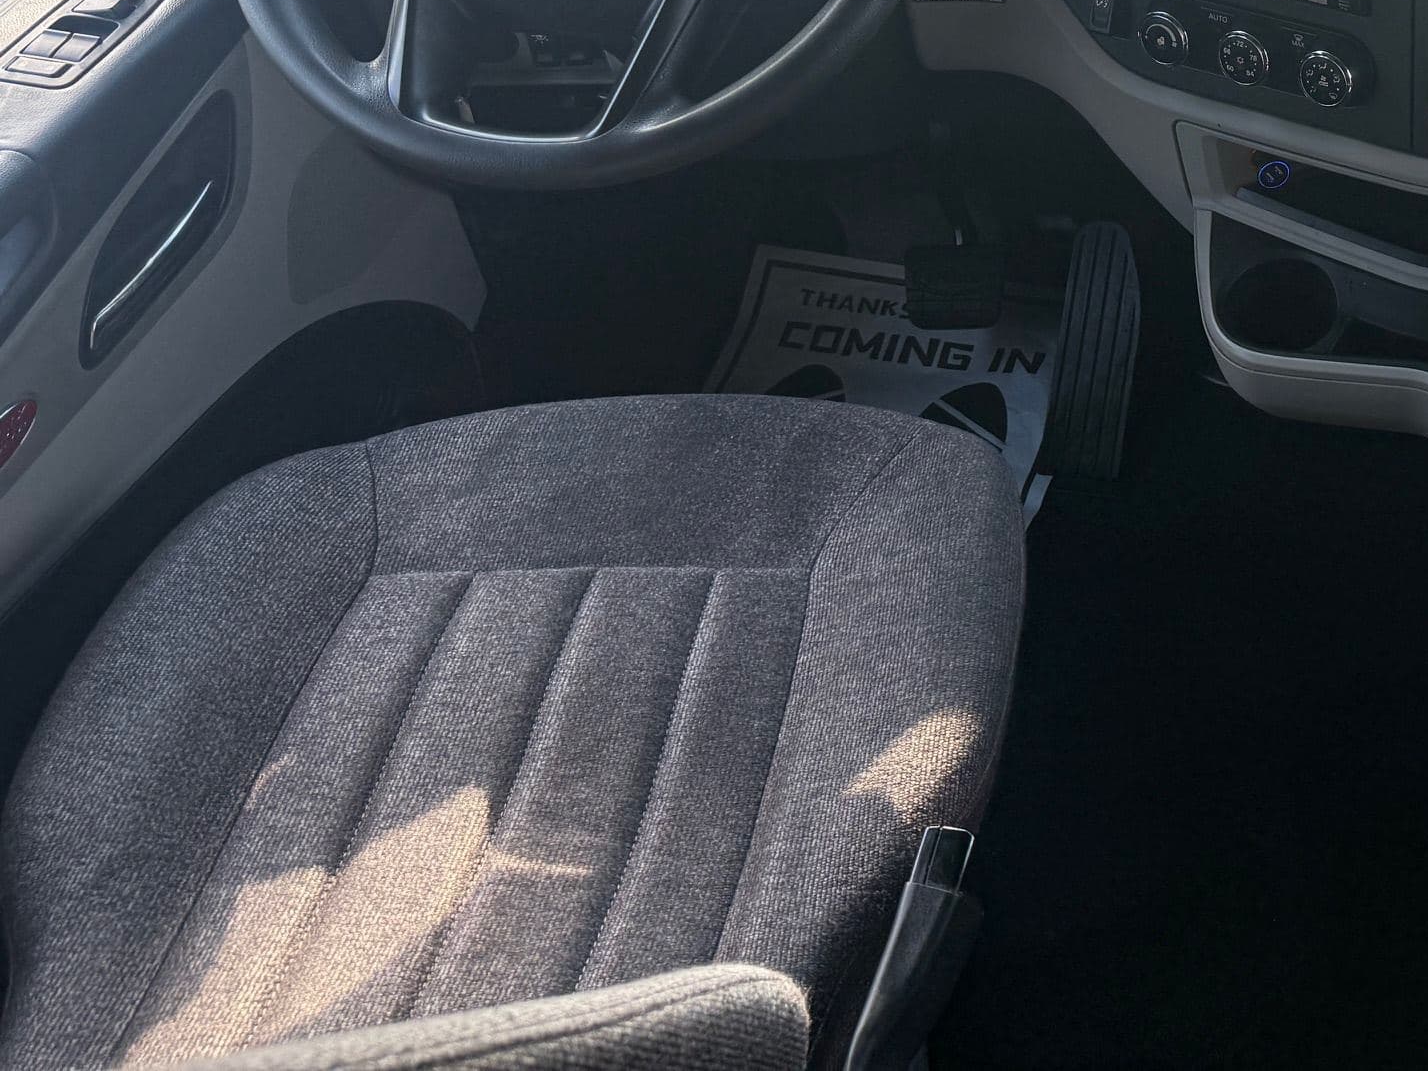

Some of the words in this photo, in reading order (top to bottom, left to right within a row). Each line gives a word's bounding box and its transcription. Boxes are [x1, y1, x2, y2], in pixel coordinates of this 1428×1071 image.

[1208, 13, 1228, 24] AUTO
[777, 320, 975, 372] COMING
[987, 347, 1046, 374] IN
